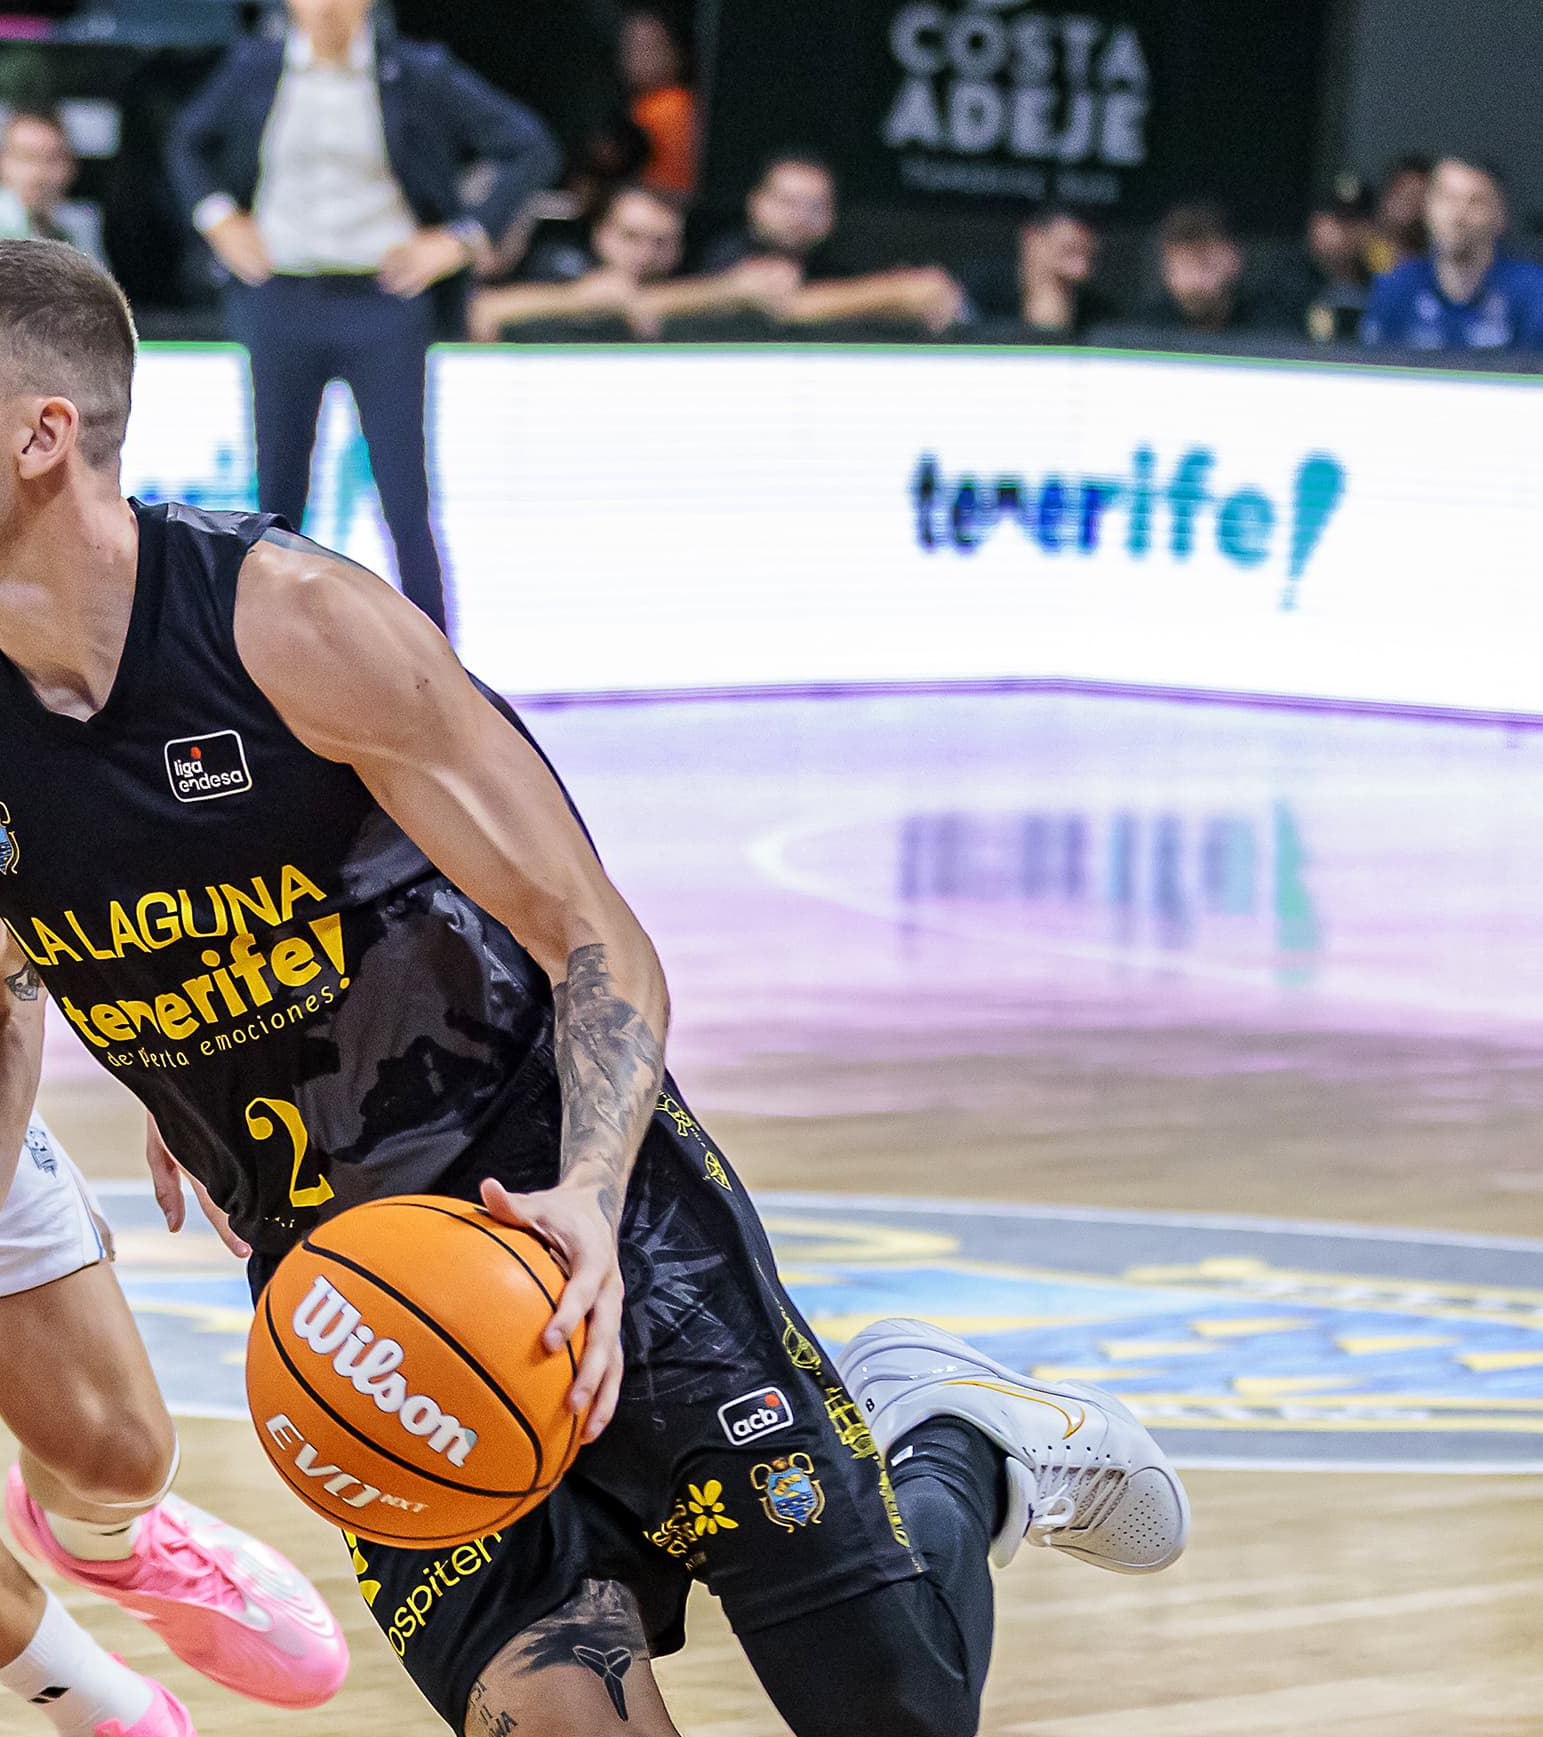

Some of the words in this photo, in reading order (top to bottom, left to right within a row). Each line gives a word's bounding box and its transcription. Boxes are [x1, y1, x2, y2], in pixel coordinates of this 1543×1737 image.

[888, 4, 1149, 90] COSTA
[882, 78, 1148, 166] ADEJE
[174, 758, 204, 778] liga
[178, 769, 244, 793] endesa
[4, 915, 83, 966] LA
[64, 864, 327, 960] LAGUNA
[62, 913, 350, 1048] tenerife!
[200, 984, 334, 1056] emociones
[245, 1097, 335, 1208] 2
[292, 1274, 478, 1468] Wilson
[265, 1413, 381, 1509] EVO
[733, 1408, 779, 1438] acb
[388, 1531, 503, 1664] ospiten
